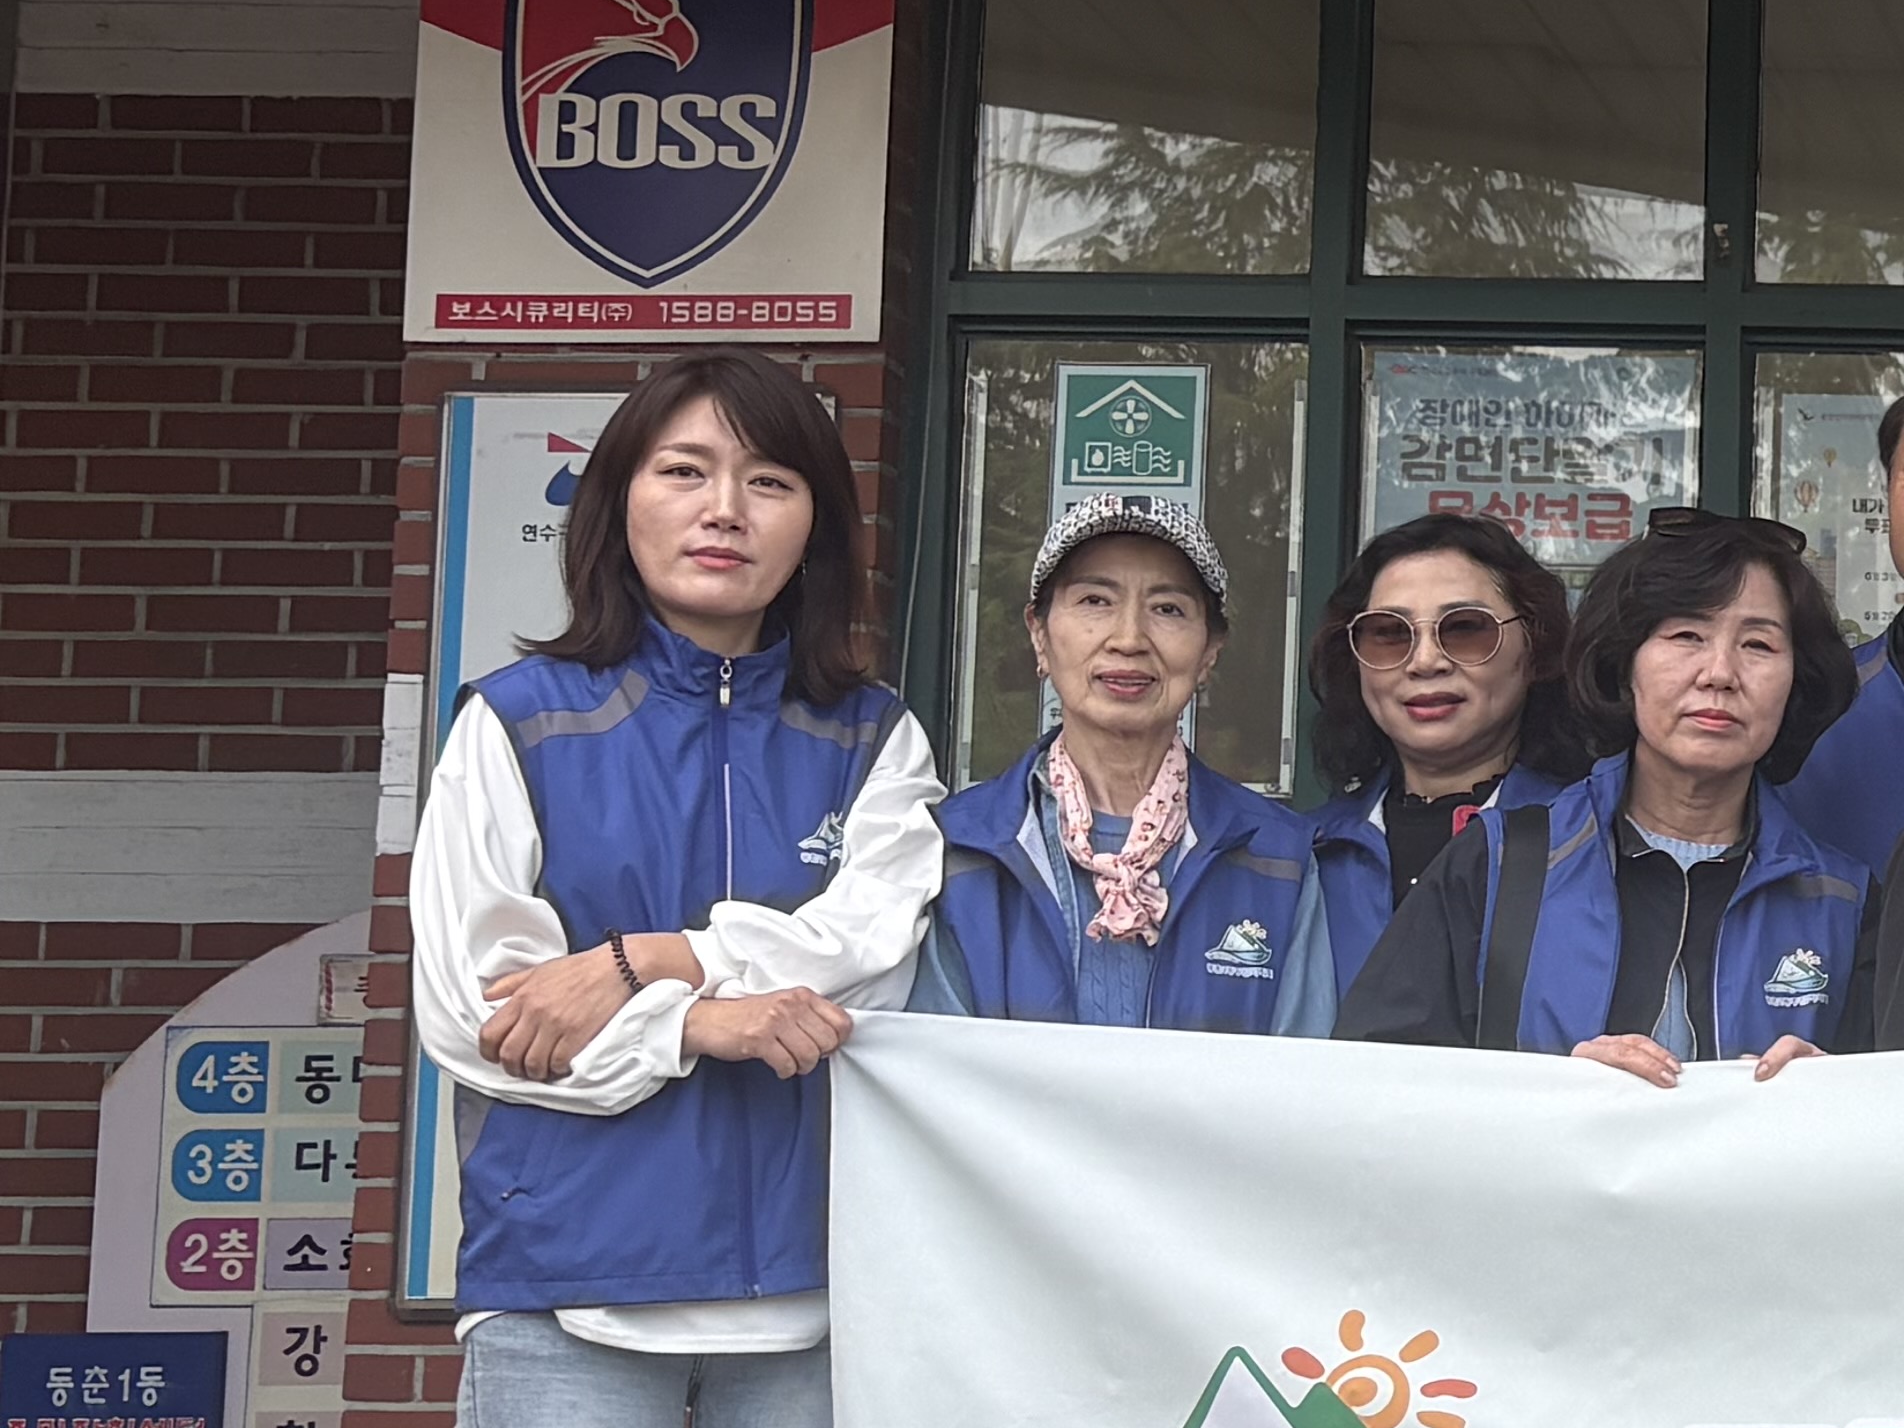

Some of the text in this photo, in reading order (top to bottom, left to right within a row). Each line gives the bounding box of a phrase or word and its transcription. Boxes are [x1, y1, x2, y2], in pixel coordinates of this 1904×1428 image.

[535, 92, 777, 169] BOSS
[448, 301, 838, 325] 보스시큐리티(주) 1588-8055
[191, 1051, 364, 1105] 4층 동
[187, 1139, 359, 1192] 3층 다
[180, 1228, 255, 1282] 2층
[46, 1365, 166, 1407] 동춘1동
